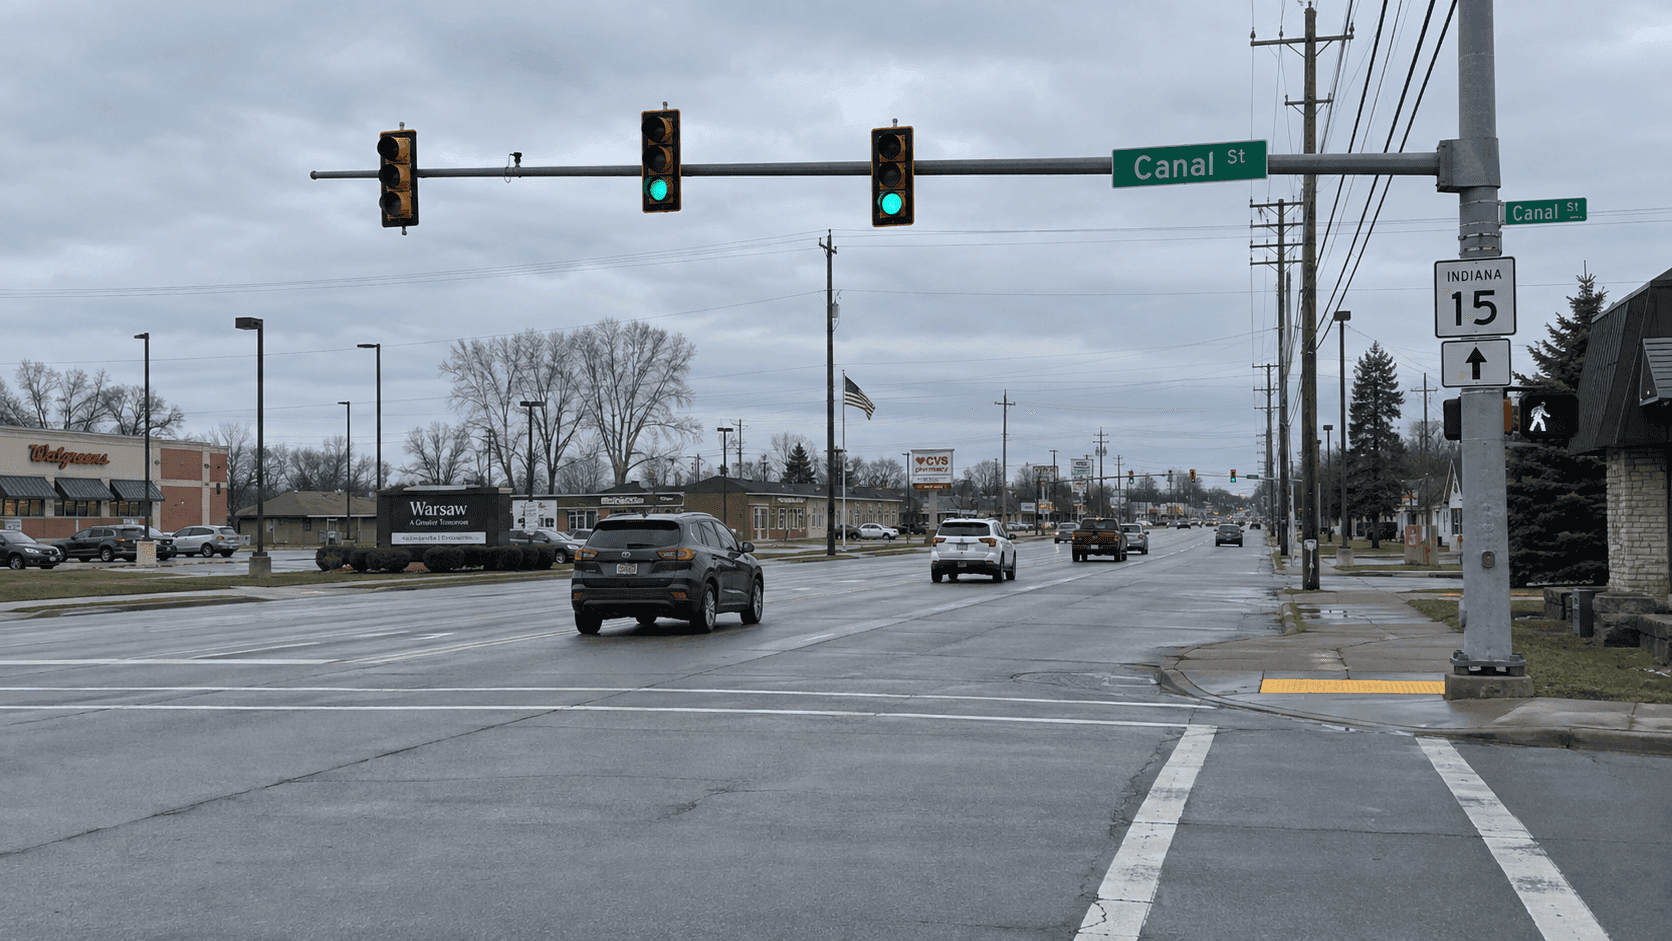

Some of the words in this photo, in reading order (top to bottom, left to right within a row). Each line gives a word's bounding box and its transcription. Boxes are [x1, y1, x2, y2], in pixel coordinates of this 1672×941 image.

[1134, 151, 1214, 180] Canal
[1227, 149, 1246, 164] St
[1513, 203, 1558, 221] Canal
[1567, 202, 1579, 212] St
[1447, 269, 1502, 282] INDIANA
[1452, 290, 1497, 326] 15
[28, 444, 110, 470] Walgreens
[926, 456, 949, 466] CVS
[409, 501, 467, 516] Warsaw
